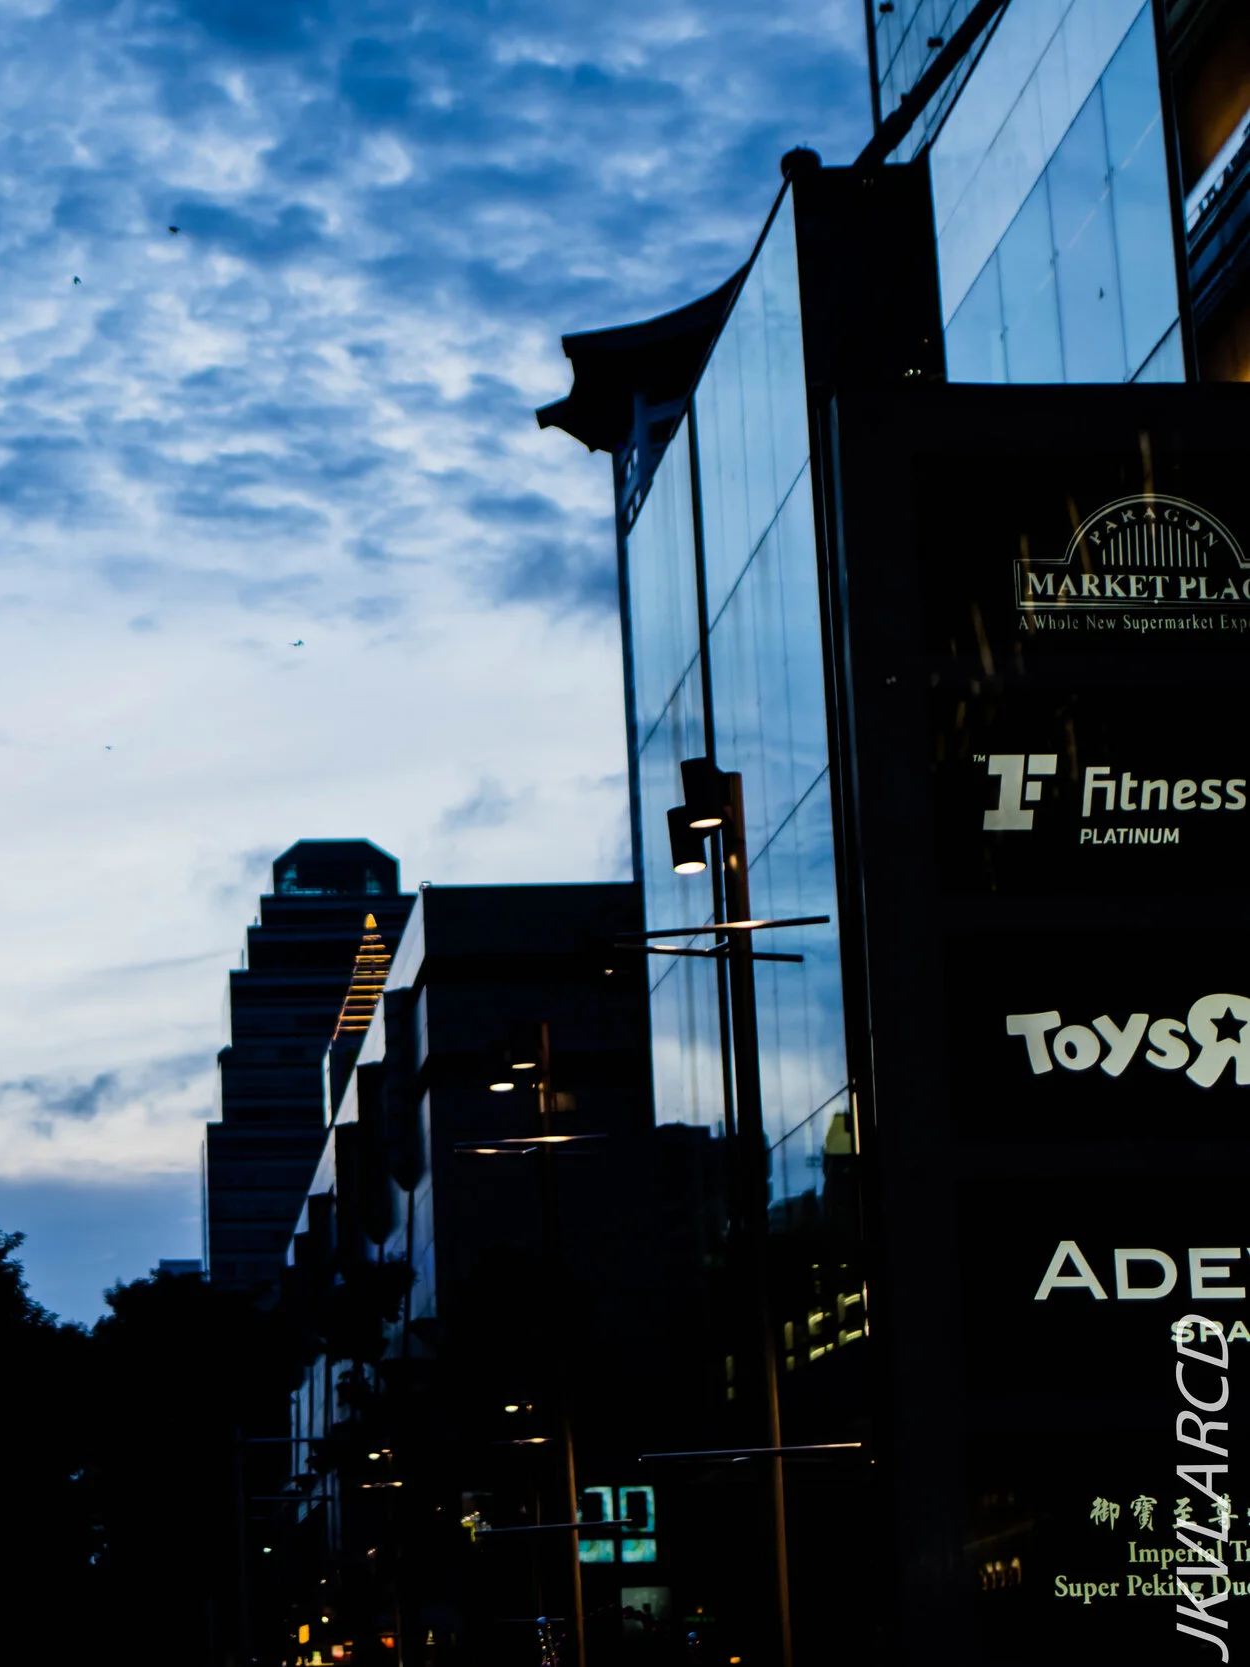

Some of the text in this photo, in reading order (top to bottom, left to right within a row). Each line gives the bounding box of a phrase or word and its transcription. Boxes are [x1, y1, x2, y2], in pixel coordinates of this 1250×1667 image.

[1088, 507, 1218, 548] PARAGON
[1027, 572, 1169, 599] MARKET
[1018, 616, 1029, 630] A
[1032, 614, 1079, 631] Whole
[1086, 615, 1118, 631] New
[1123, 613, 1213, 634] Supermarket
[1081, 766, 1247, 818] Fitness
[1080, 827, 1180, 845] PLATINUM
[1034, 1240, 1250, 1301] ADE
[1170, 1320, 1250, 1343] SPA
[1127, 1540, 1225, 1570] Imperial
[1054, 1574, 1120, 1604] Super
[1126, 1573, 1205, 1602] Peking
